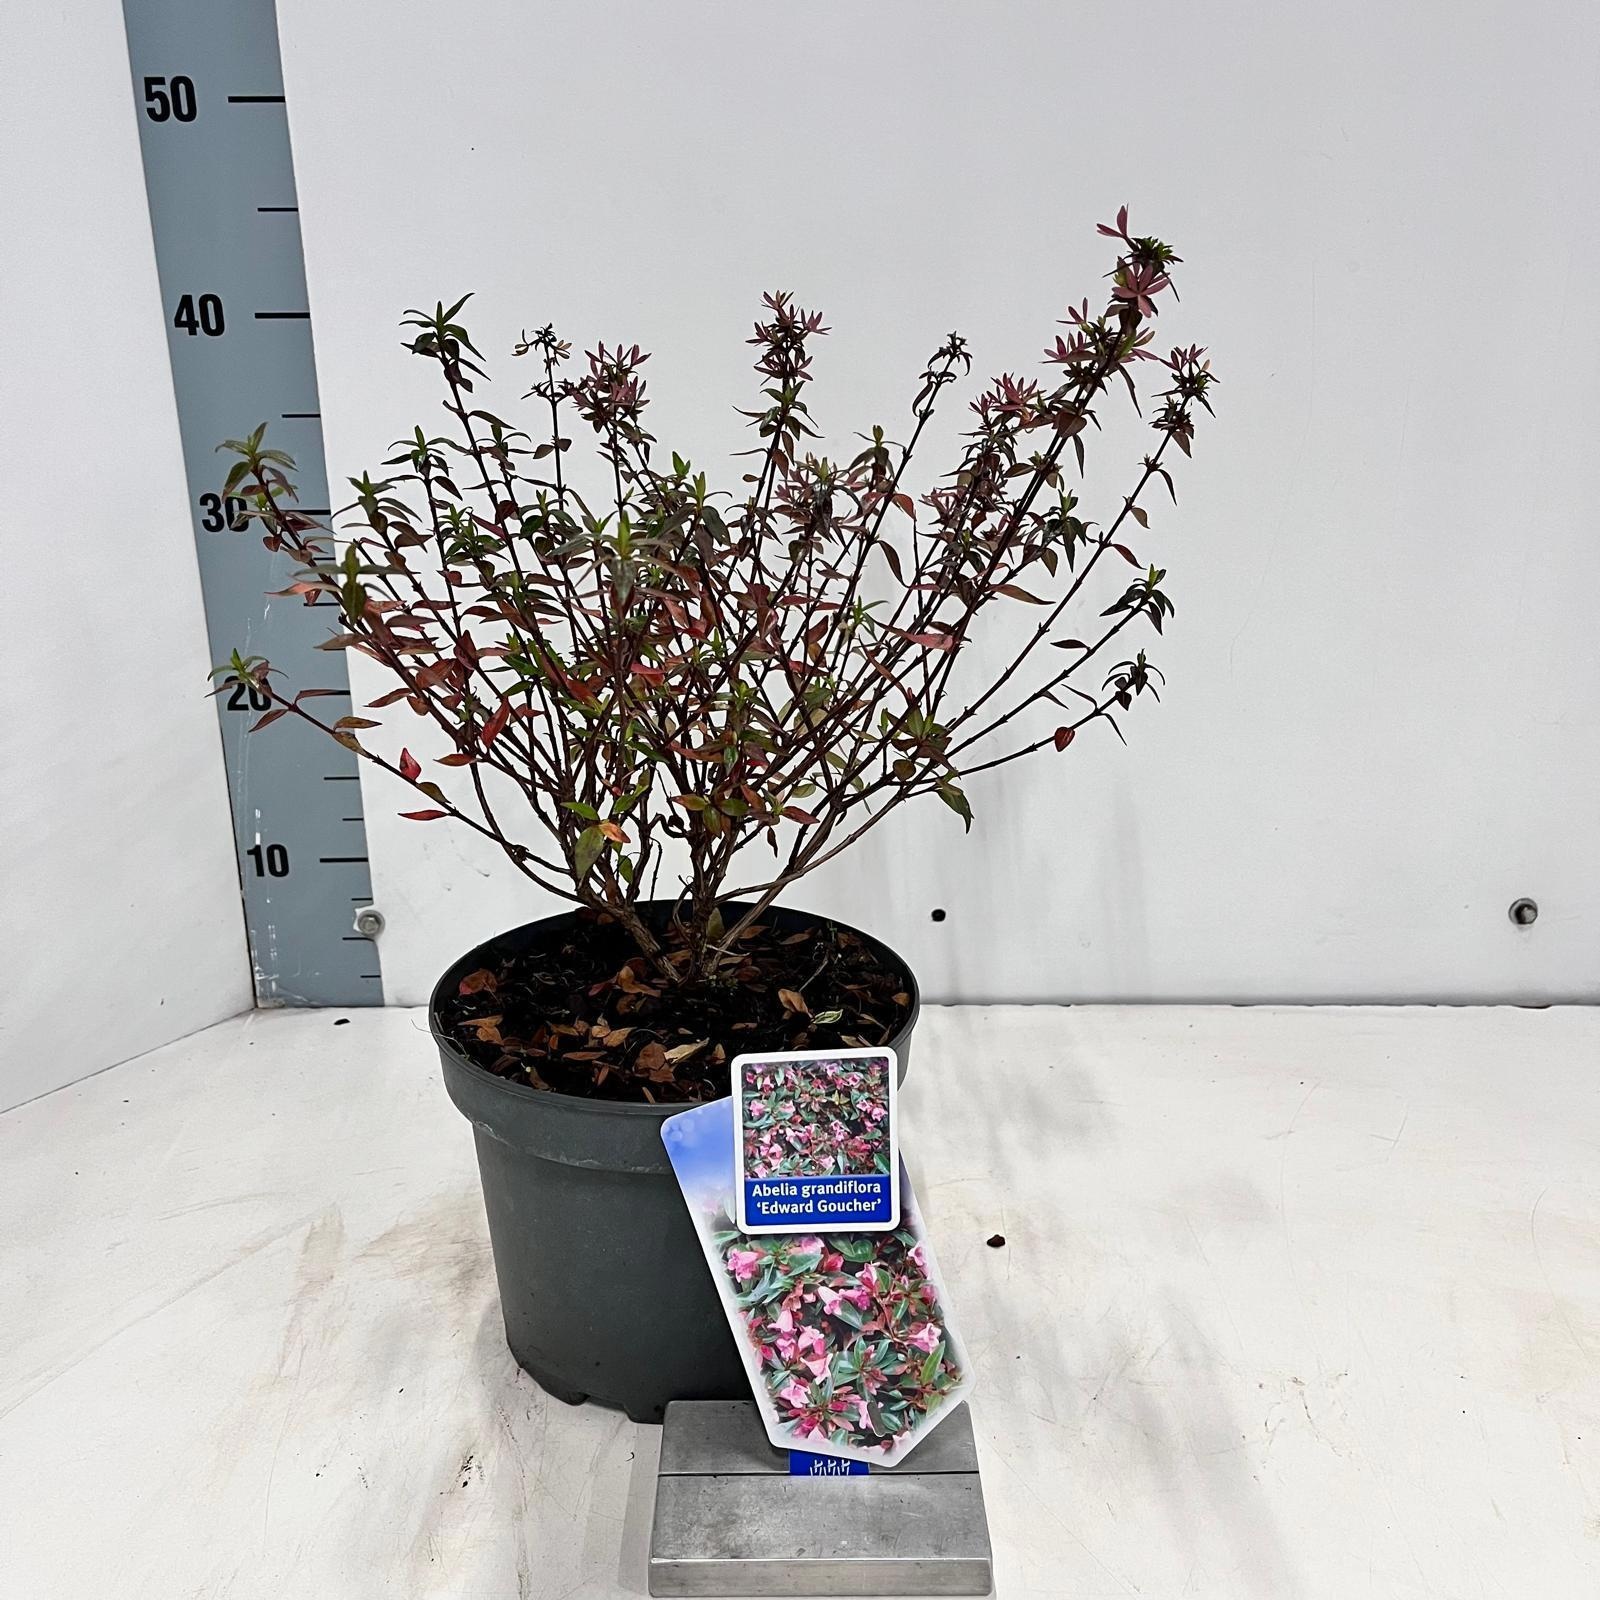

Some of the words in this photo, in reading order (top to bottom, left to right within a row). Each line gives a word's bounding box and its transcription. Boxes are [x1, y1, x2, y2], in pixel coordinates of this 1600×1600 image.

[143, 75, 197, 123] 50
[173, 293, 225, 337] 40
[199, 492, 250, 532] 30
[246, 843, 290, 877] 10
[752, 1183, 798, 1197] Abelia
[801, 1180, 881, 1198] grandiflora
